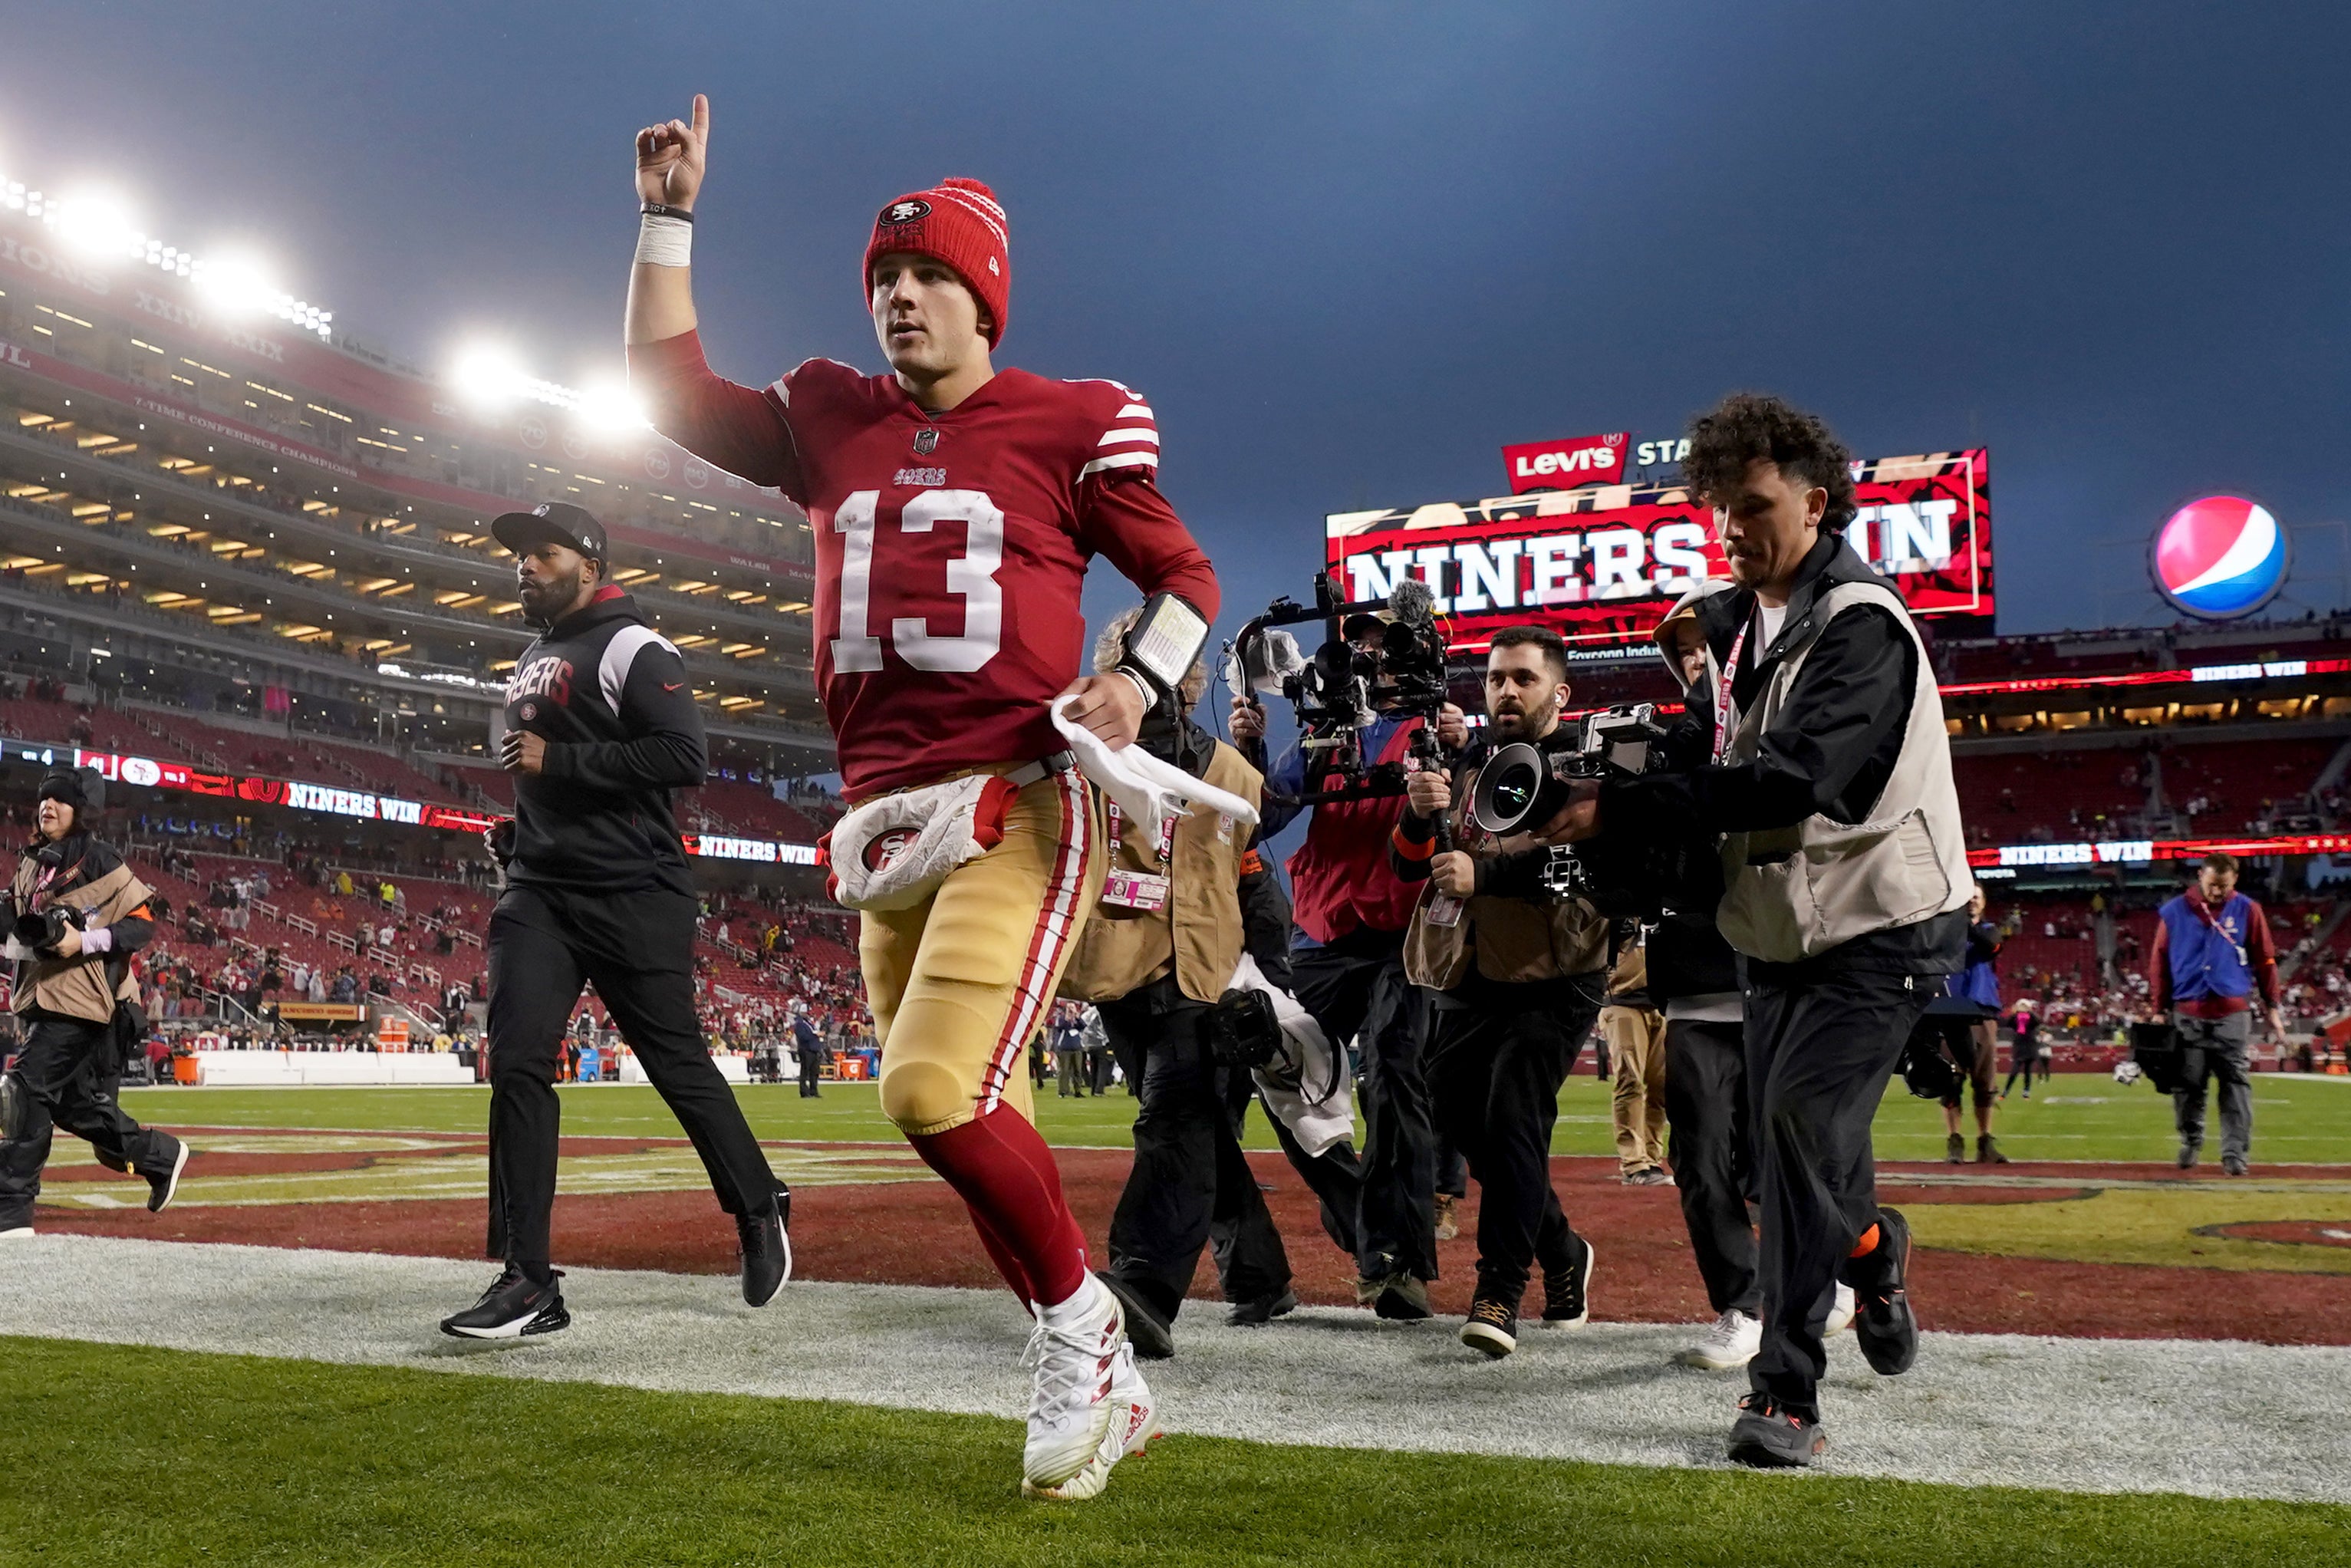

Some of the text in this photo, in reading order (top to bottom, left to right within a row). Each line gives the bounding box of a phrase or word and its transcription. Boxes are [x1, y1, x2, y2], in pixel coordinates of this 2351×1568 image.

[189, 415, 278, 452] CONFERENCE
[280, 445, 357, 479] CHAMPIONS
[1638, 439, 1692, 466] STA
[893, 467, 947, 486] 49ERS
[1347, 499, 1957, 612] NINERS IN
[829, 489, 1005, 674] 13
[2191, 660, 2307, 681] NINERS WIN
[1720, 681, 1733, 707] 49ERS
[41, 749, 53, 766] 4
[288, 781, 421, 824] NINERS WIN
[699, 835, 816, 865] NINERS WIN
[1999, 841, 2153, 865] NINERS WIN
[1974, 869, 2017, 879] TOYOTA
[1121, 1405, 1150, 1446] adidas
